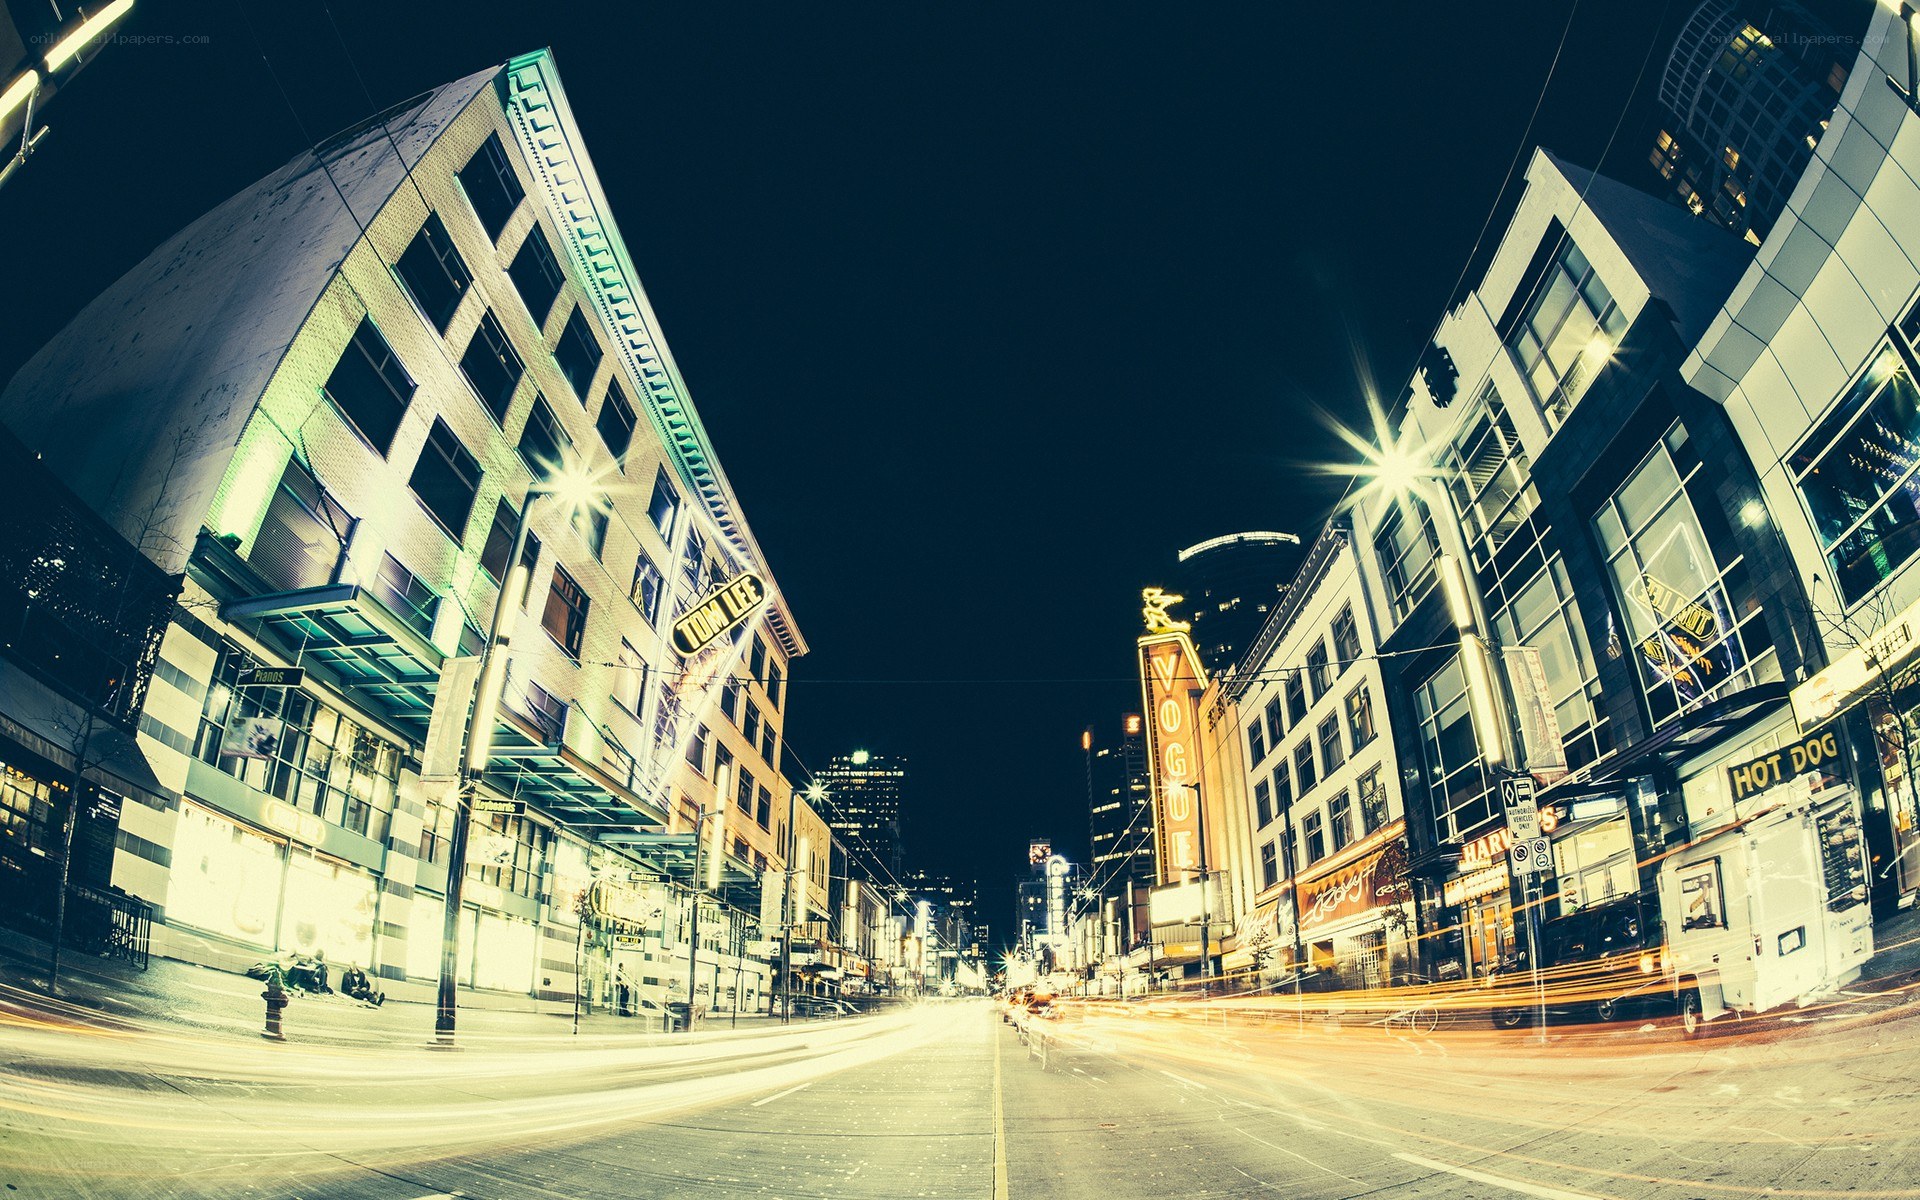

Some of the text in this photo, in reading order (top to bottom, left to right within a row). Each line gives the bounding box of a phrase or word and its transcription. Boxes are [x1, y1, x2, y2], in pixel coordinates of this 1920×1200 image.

[676, 576, 762, 649] TOM LEE
[255, 670, 284, 682] Pianos
[1152, 653, 1194, 867] VOGUE
[1733, 732, 1838, 799] HOT DOG
[1508, 805, 1535, 815] AUTHORIZED
[1513, 814, 1533, 822] VEHICLES
[1310, 870, 1365, 923] Roxy
